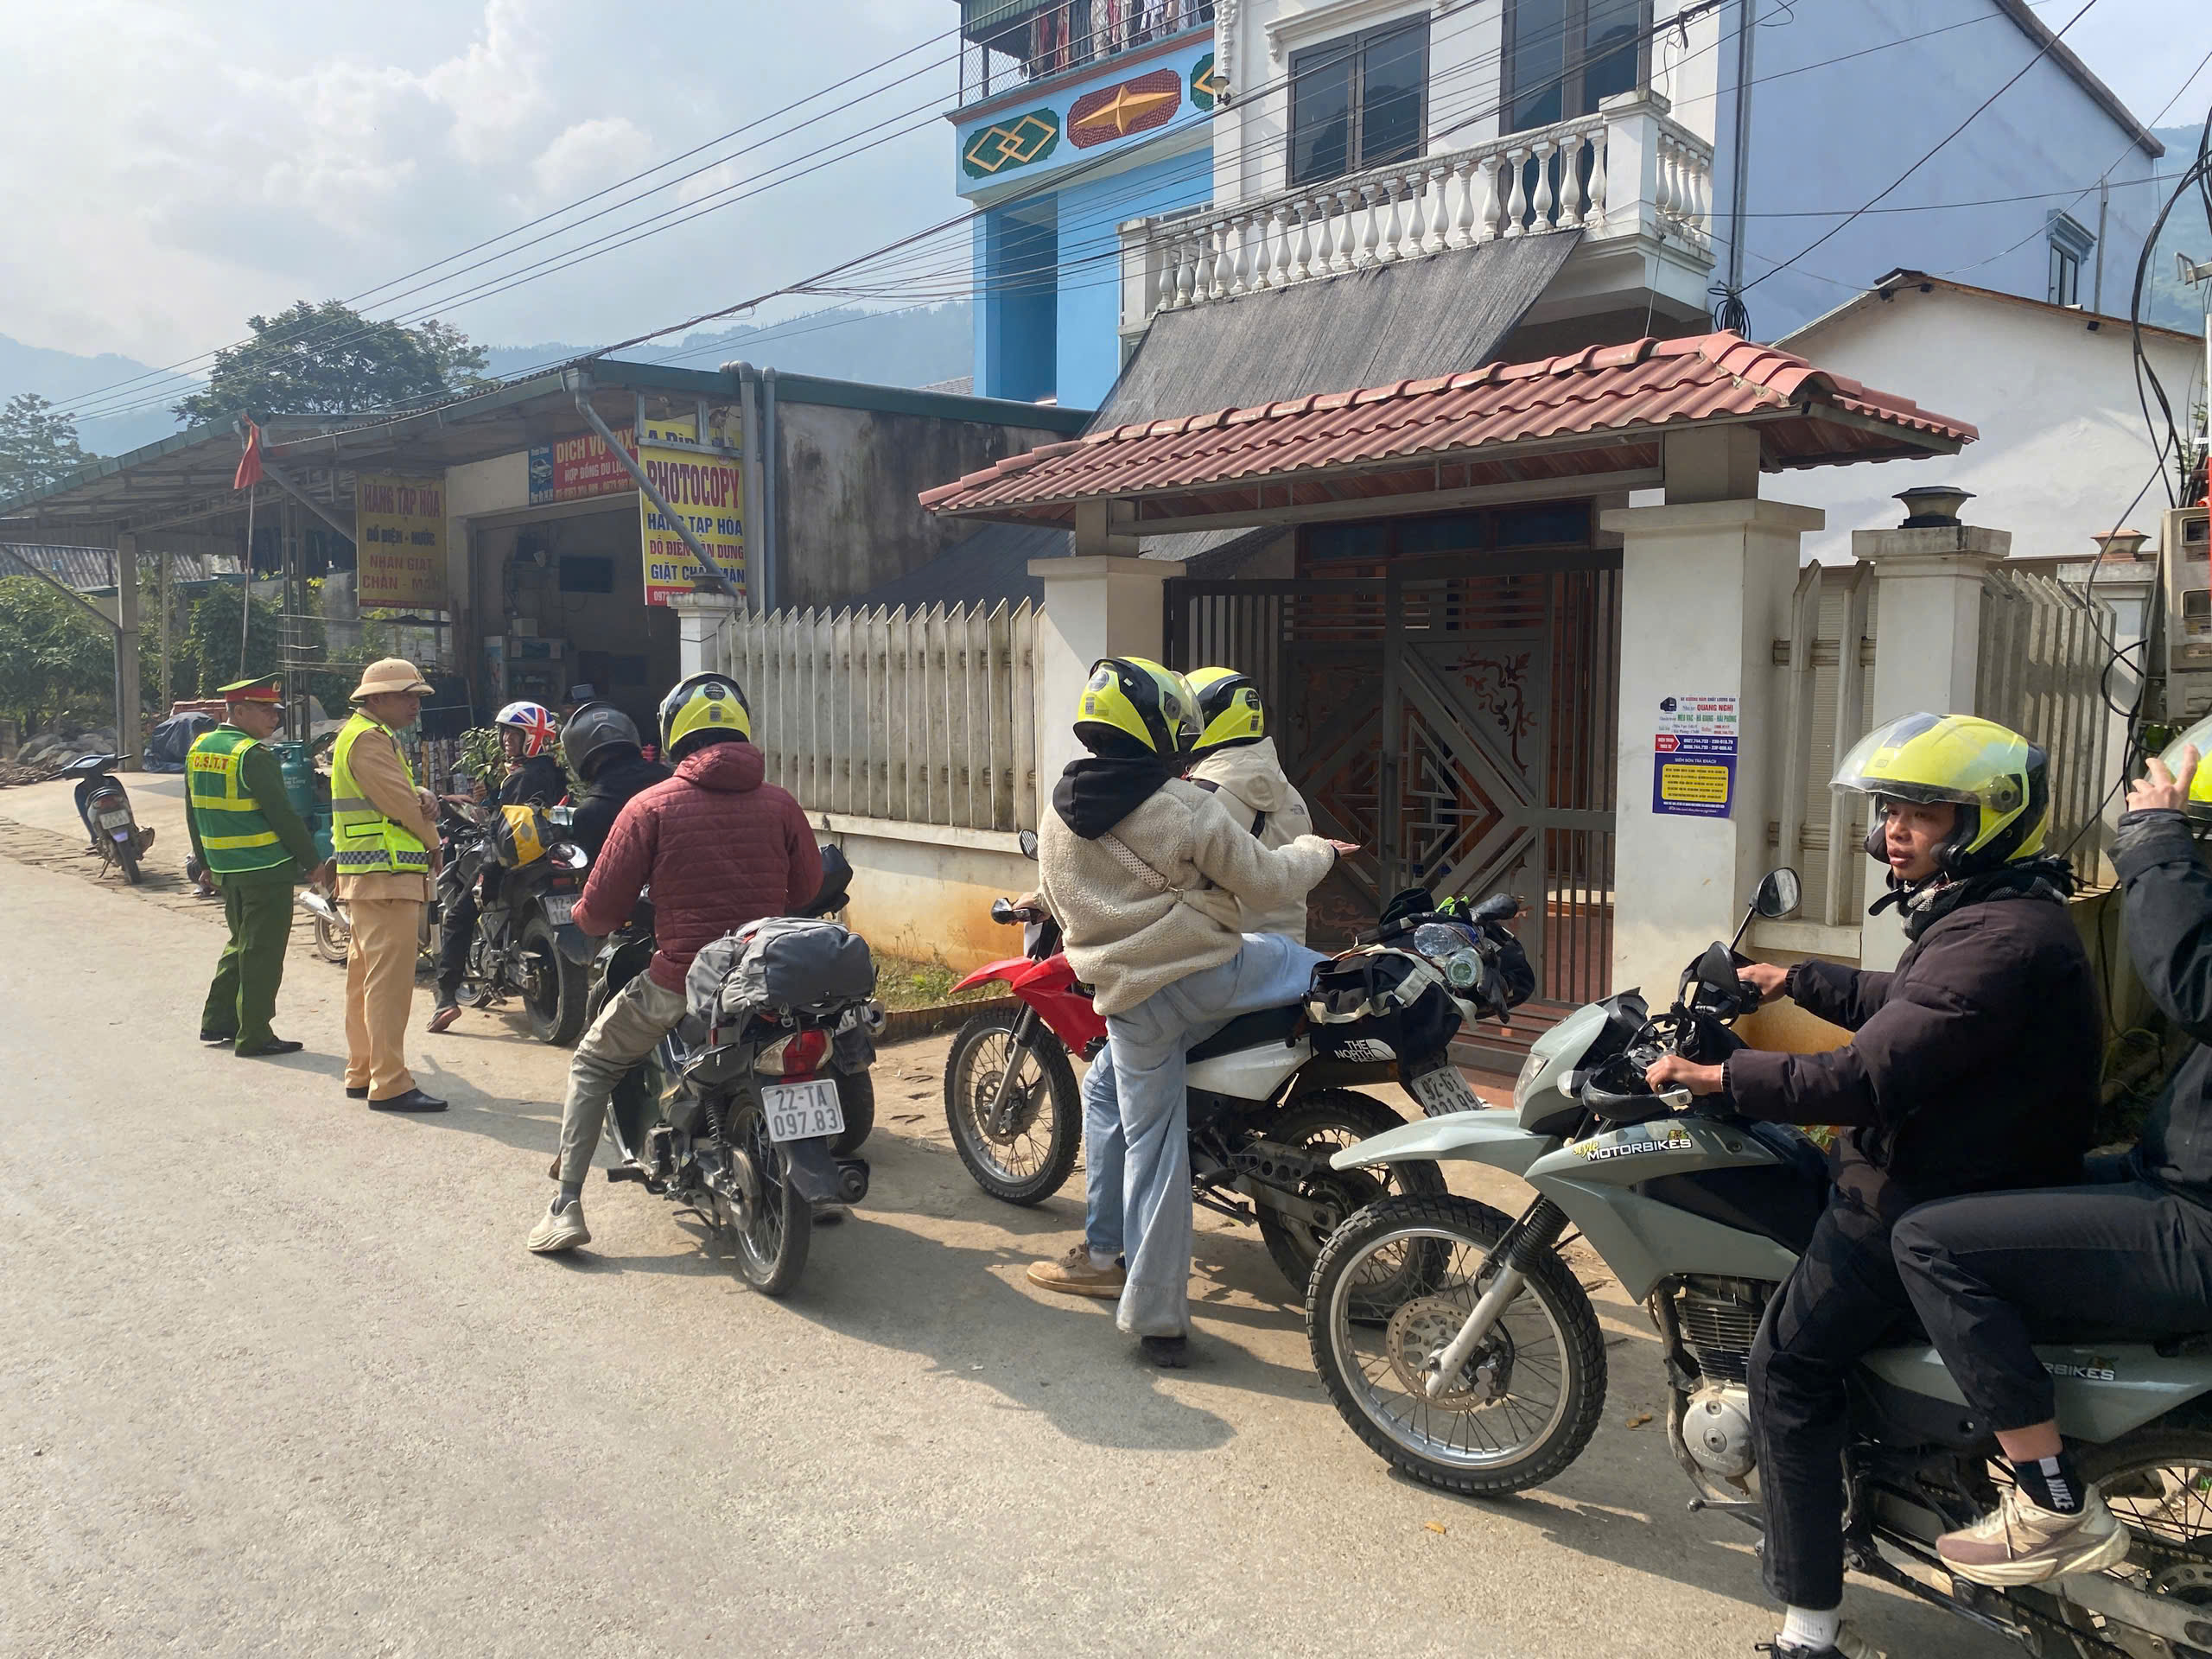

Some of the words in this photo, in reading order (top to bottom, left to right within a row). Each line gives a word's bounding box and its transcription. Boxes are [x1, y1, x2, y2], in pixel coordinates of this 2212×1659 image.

[556, 437, 585, 467] DỊCH
[601, 461, 611, 476] DU
[613, 460, 629, 477] LỊC
[646, 460, 740, 509] PHOTOCOPY
[688, 516, 713, 537] TẠP
[717, 516, 743, 536] HÓA
[649, 534, 664, 556] ĐỒ
[666, 538, 691, 559] ĐIỆN
[651, 562, 677, 583] GIẶT
[1333, 1048, 1374, 1058] NORTH
[1344, 1039, 1368, 1051] THE
[776, 1084, 828, 1112] 22-TA
[773, 1109, 838, 1137] 097.83
[1572, 1140, 1600, 1158] style
[1586, 1138, 1693, 1161] MOTORBIKES
[2045, 1478, 2075, 1510] NIKE
